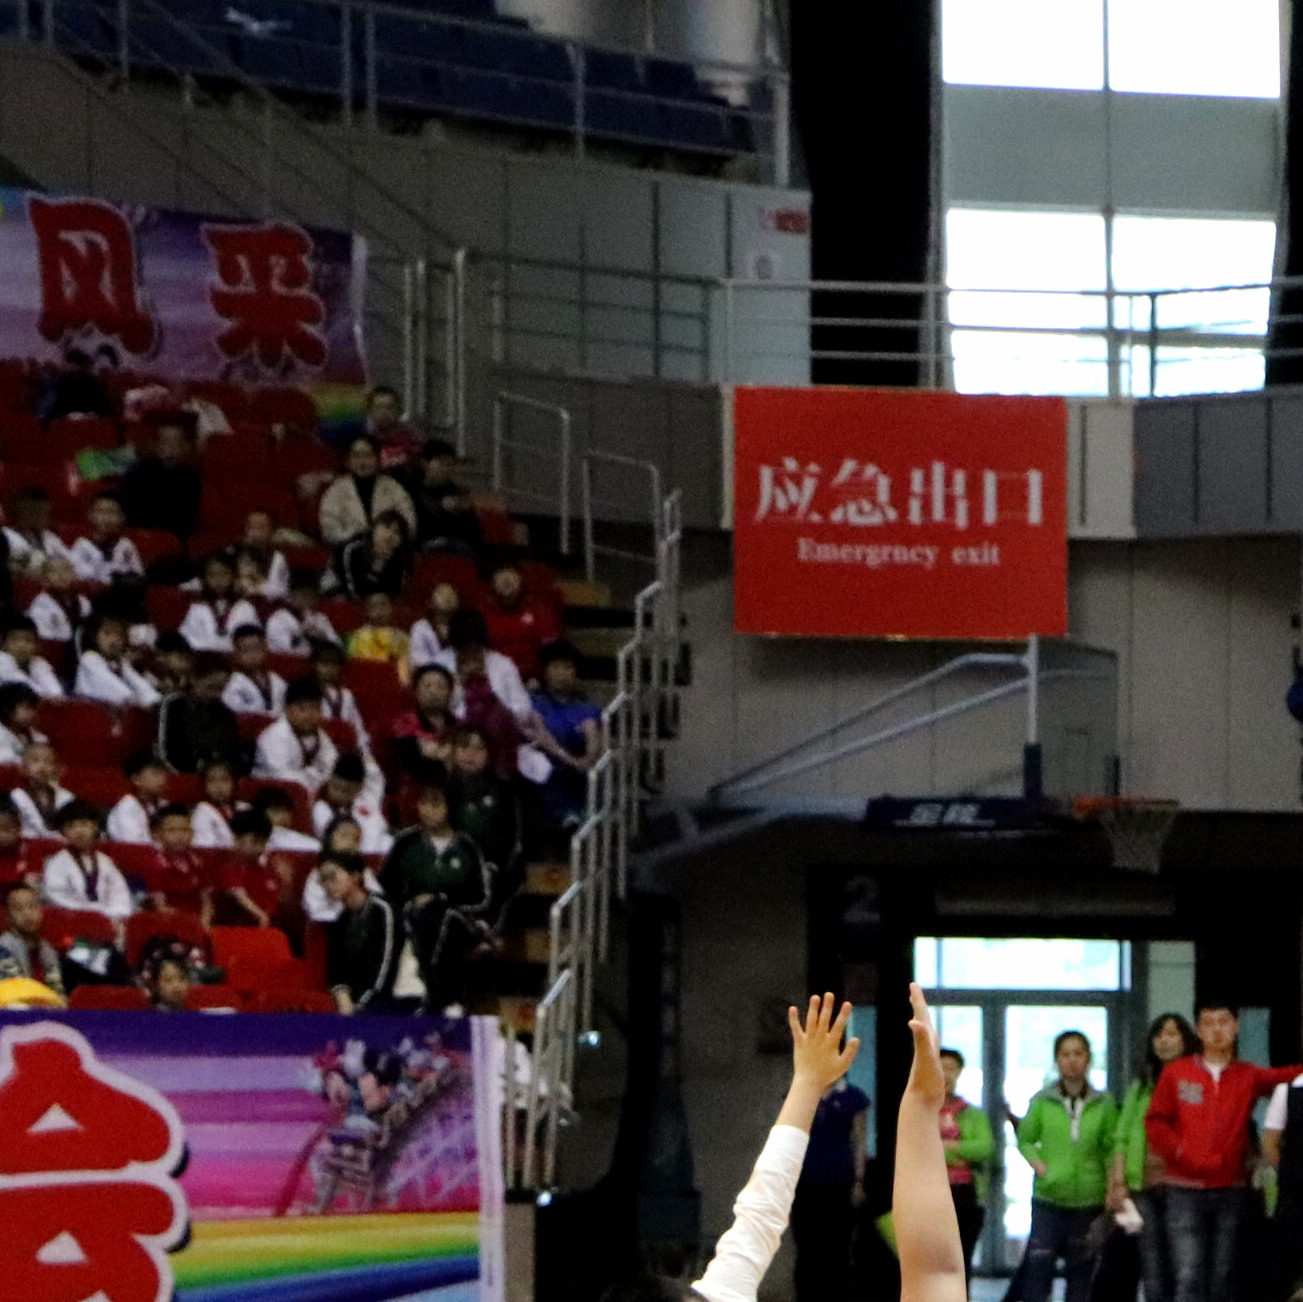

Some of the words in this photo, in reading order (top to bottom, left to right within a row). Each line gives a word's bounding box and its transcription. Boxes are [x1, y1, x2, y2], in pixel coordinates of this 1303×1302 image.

[28, 190, 328, 372] 风采
[755, 456, 1043, 529] 应急出口
[951, 543, 1001, 565] exit
[842, 876, 882, 924] 2
